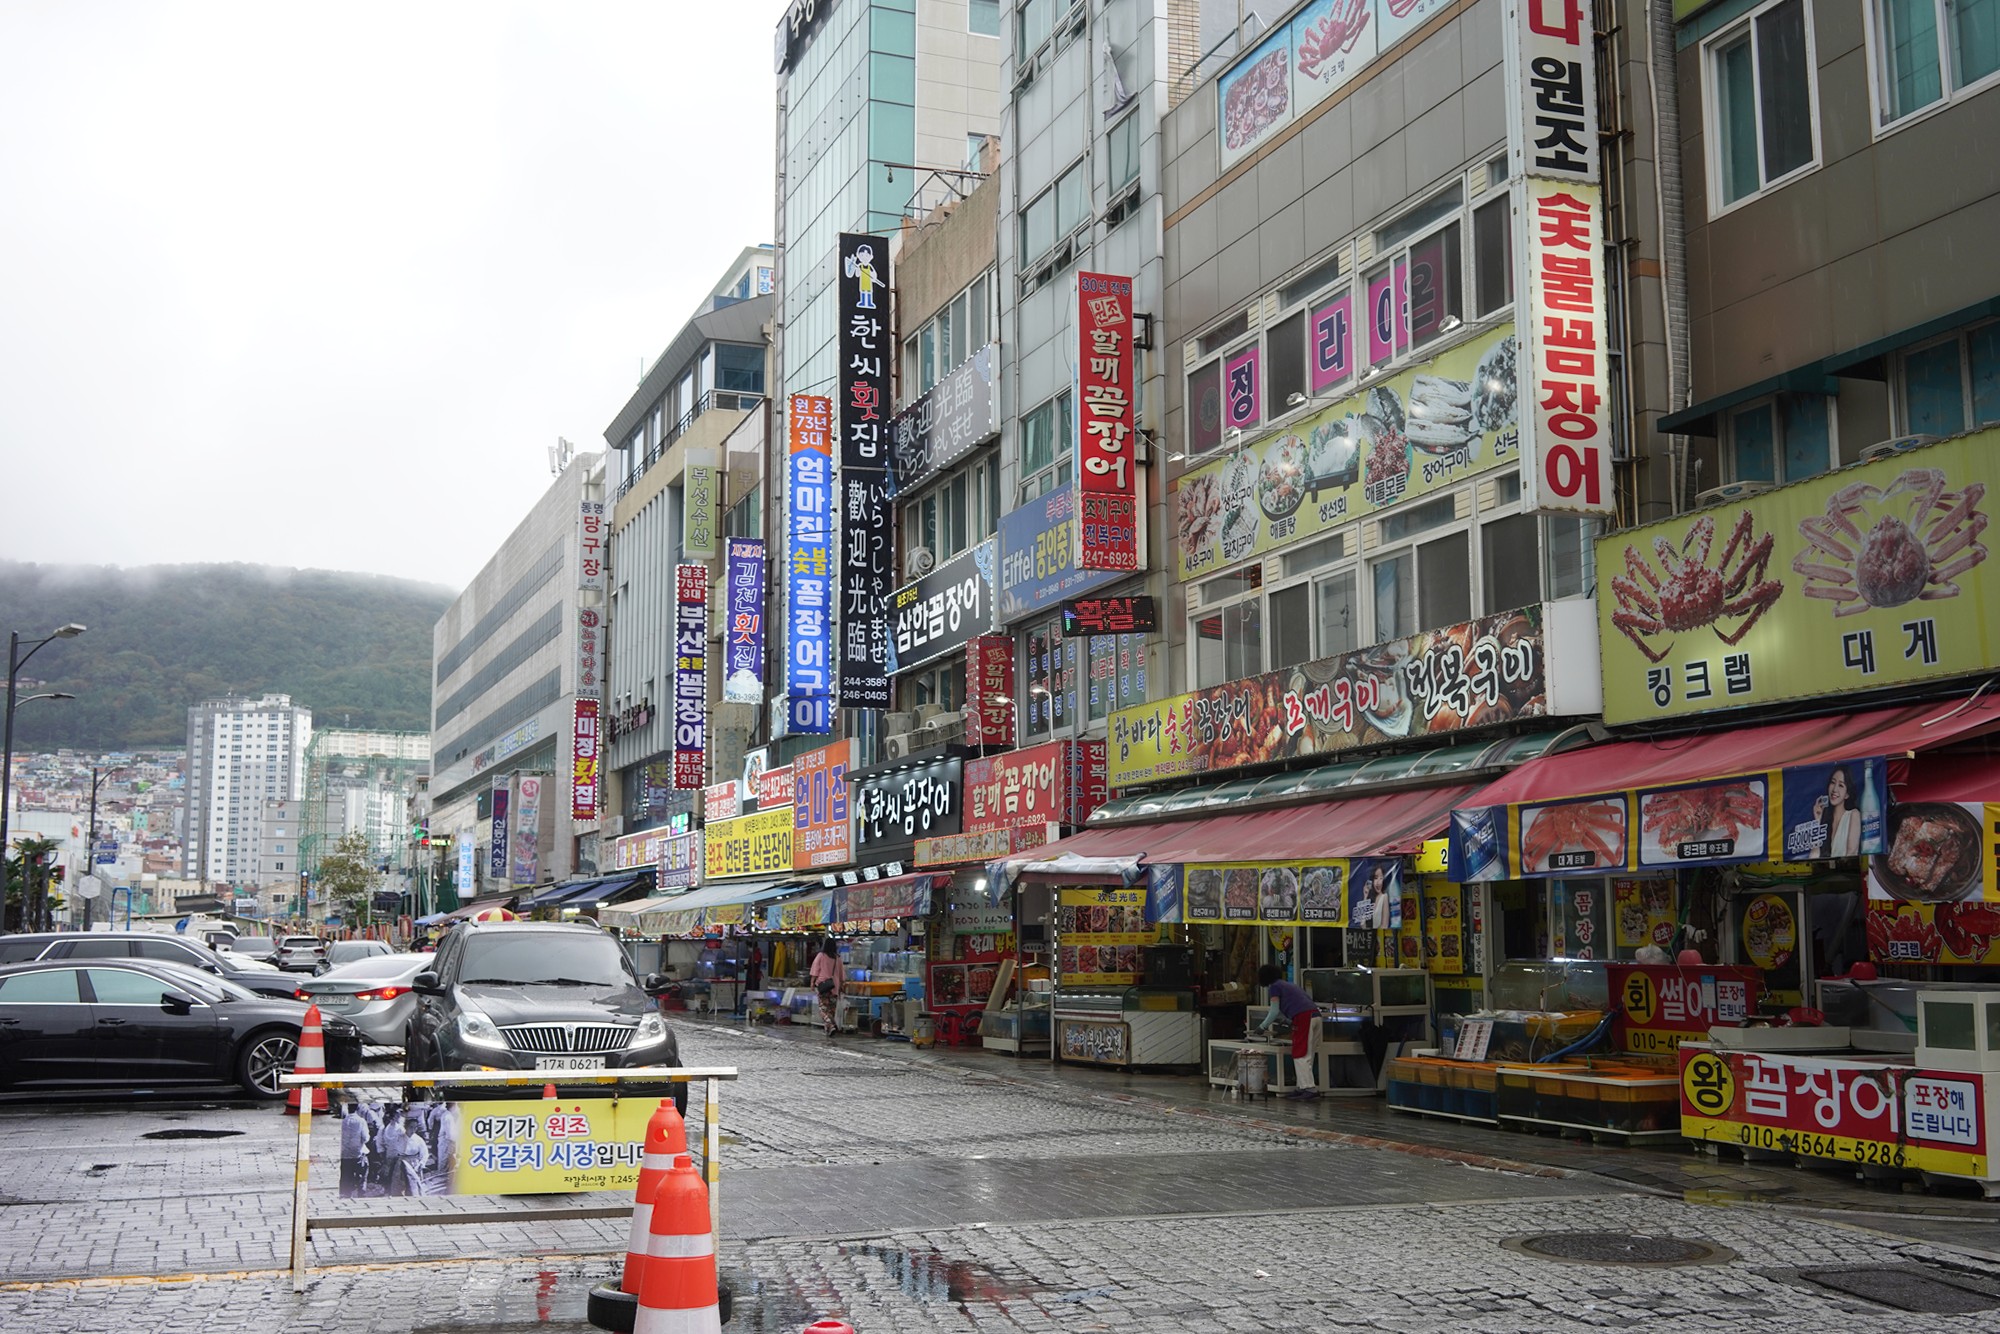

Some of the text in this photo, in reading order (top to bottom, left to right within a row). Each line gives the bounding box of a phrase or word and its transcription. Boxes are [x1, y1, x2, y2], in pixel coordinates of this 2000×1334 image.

[1531, 56, 1588, 174] 원조
[1537, 193, 1601, 504] 숯불꼼장어
[850, 314, 881, 457] 한씨횟집
[795, 398, 826, 414] 원조
[795, 415, 828, 431] 73년
[799, 432, 824, 446] 3대
[1422, 450, 1470, 483] 장어구이
[581, 502, 603, 515] 동명
[691, 467, 709, 548] 부성수산
[795, 457, 826, 543] 엄마집
[1085, 499, 1134, 523] 조개구이
[1223, 484, 1255, 513] 생선구이
[1318, 496, 1348, 523] 생선회
[1085, 524, 1134, 550] 전복구이
[1270, 517, 1296, 541] 해물탕
[582, 516, 601, 577] 당구장
[1003, 518, 1075, 592] Eiffel 공인중
[1085, 550, 1135, 567] 247-6923
[1185, 547, 1215, 573] 새우구이
[682, 567, 704, 578] 원조
[793, 547, 828, 576] 숯불
[848, 480, 868, 663] 歡迎光臨
[870, 483, 885, 664] いらっしゃいませ
[679, 578, 704, 589] 75년
[683, 588, 702, 600] 3대
[896, 573, 981, 654] 삼한꼼장어
[678, 605, 704, 655] 부산
[844, 676, 887, 688] 244-3589
[1647, 652, 1752, 707] 킹크랩
[843, 690, 888, 701] 246-0405
[1114, 636, 1534, 763] 참바다 숯불 꼼장어 조개구이 전복구이
[677, 673, 703, 748] 꼼장어
[574, 717, 598, 805] 미정횟집
[677, 764, 702, 774] 75년
[679, 753, 701, 763] 원조
[680, 775, 699, 785] 3대
[1004, 756, 1056, 814] 꼼장어
[1089, 744, 1107, 815] 전복구
[796, 762, 848, 829] 엄마집
[903, 776, 950, 836] 꼼장어
[708, 842, 723, 875] 원조
[725, 837, 751, 874] 연탄불
[1684, 844, 1708, 857] 킹크랩
[1889, 942, 1920, 958] 킹크랩
[1627, 977, 1652, 1018] 회
[569, 1057, 600, 1070] 0621
[1691, 1057, 1900, 1134] 왕 꼼장어
[1915, 1084, 1965, 1111] 포장해
[473, 1115, 589, 1140] 여기가 원조
[1910, 1112, 1972, 1139] 드립니다
[473, 1143, 543, 1171] 자갈치
